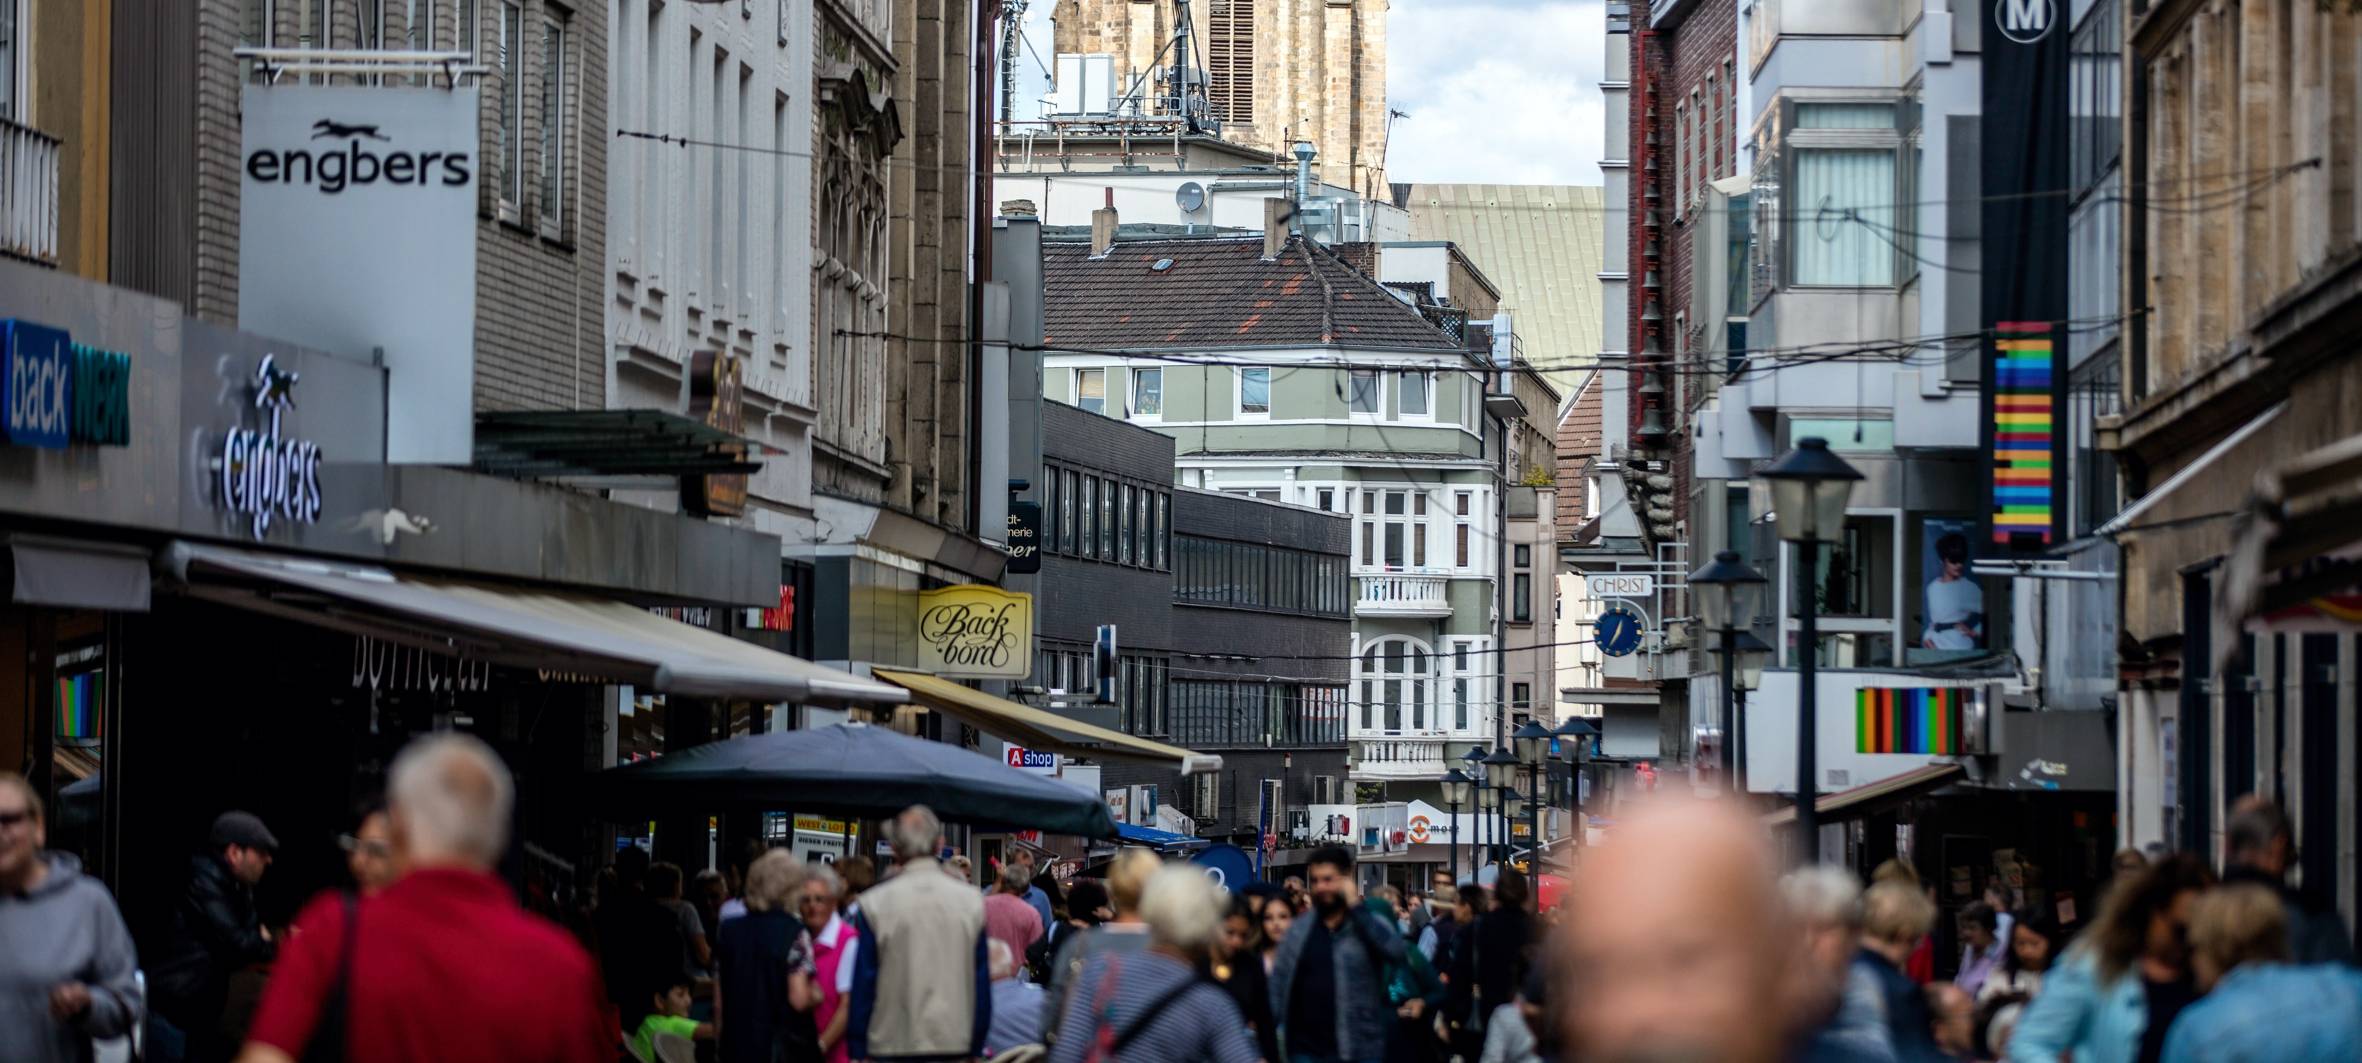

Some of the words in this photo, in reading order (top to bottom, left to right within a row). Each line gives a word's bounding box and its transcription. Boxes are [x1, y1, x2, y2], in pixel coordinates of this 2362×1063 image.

[2006, 0, 2044, 30] M
[247, 139, 471, 194] engbers
[10, 331, 67, 436] back
[222, 404, 322, 543] engbers
[1592, 578, 1646, 593] CHRIST
[921, 602, 1016, 647] Back
[936, 634, 1009, 668] bord
[1010, 750, 1022, 766] A
[1024, 752, 1053, 767] shop
